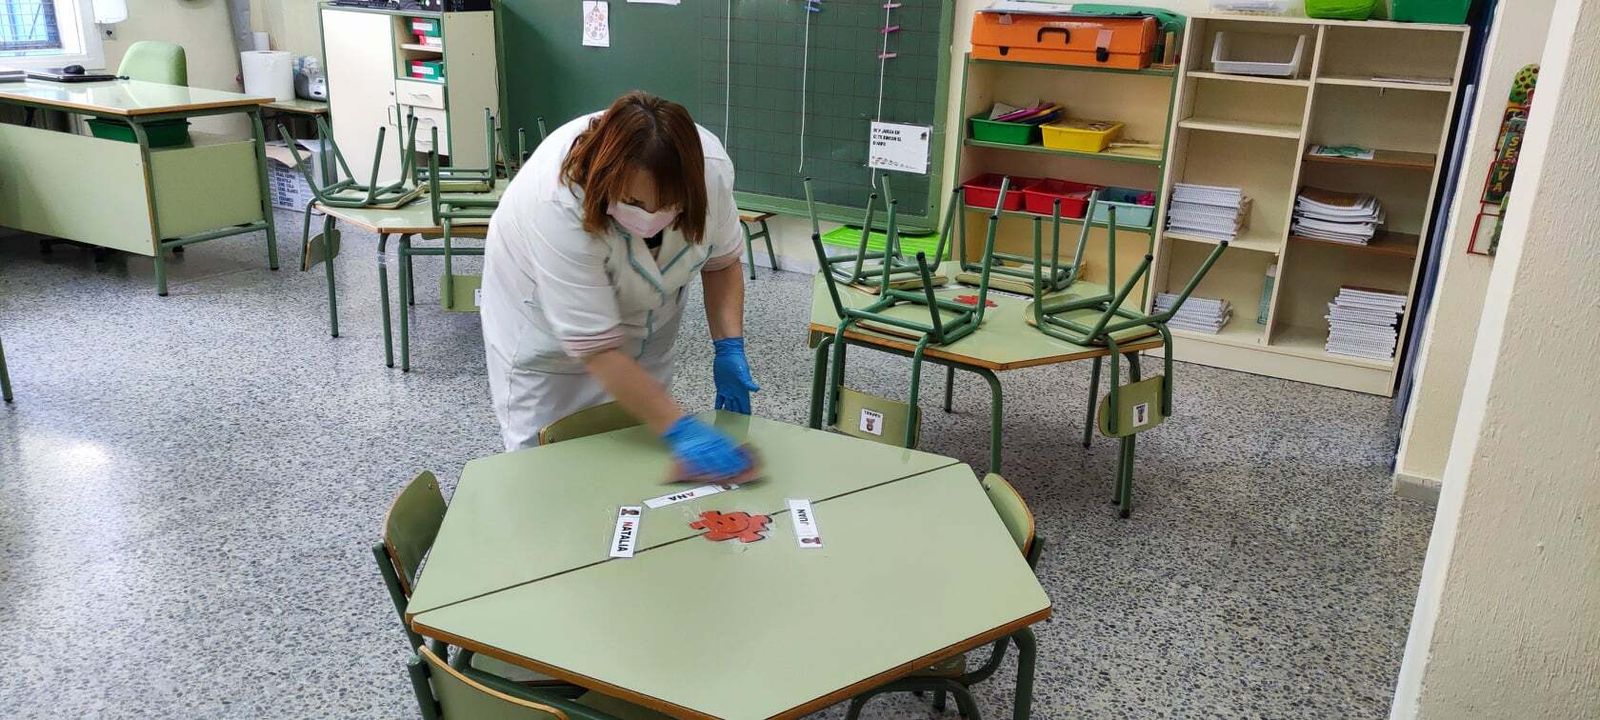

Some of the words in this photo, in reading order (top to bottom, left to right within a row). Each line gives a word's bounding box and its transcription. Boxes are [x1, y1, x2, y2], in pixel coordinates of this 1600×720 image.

[668, 491, 694, 501] ANA
[797, 508, 809, 525] JUAN
[617, 521, 633, 551] NATALIA
